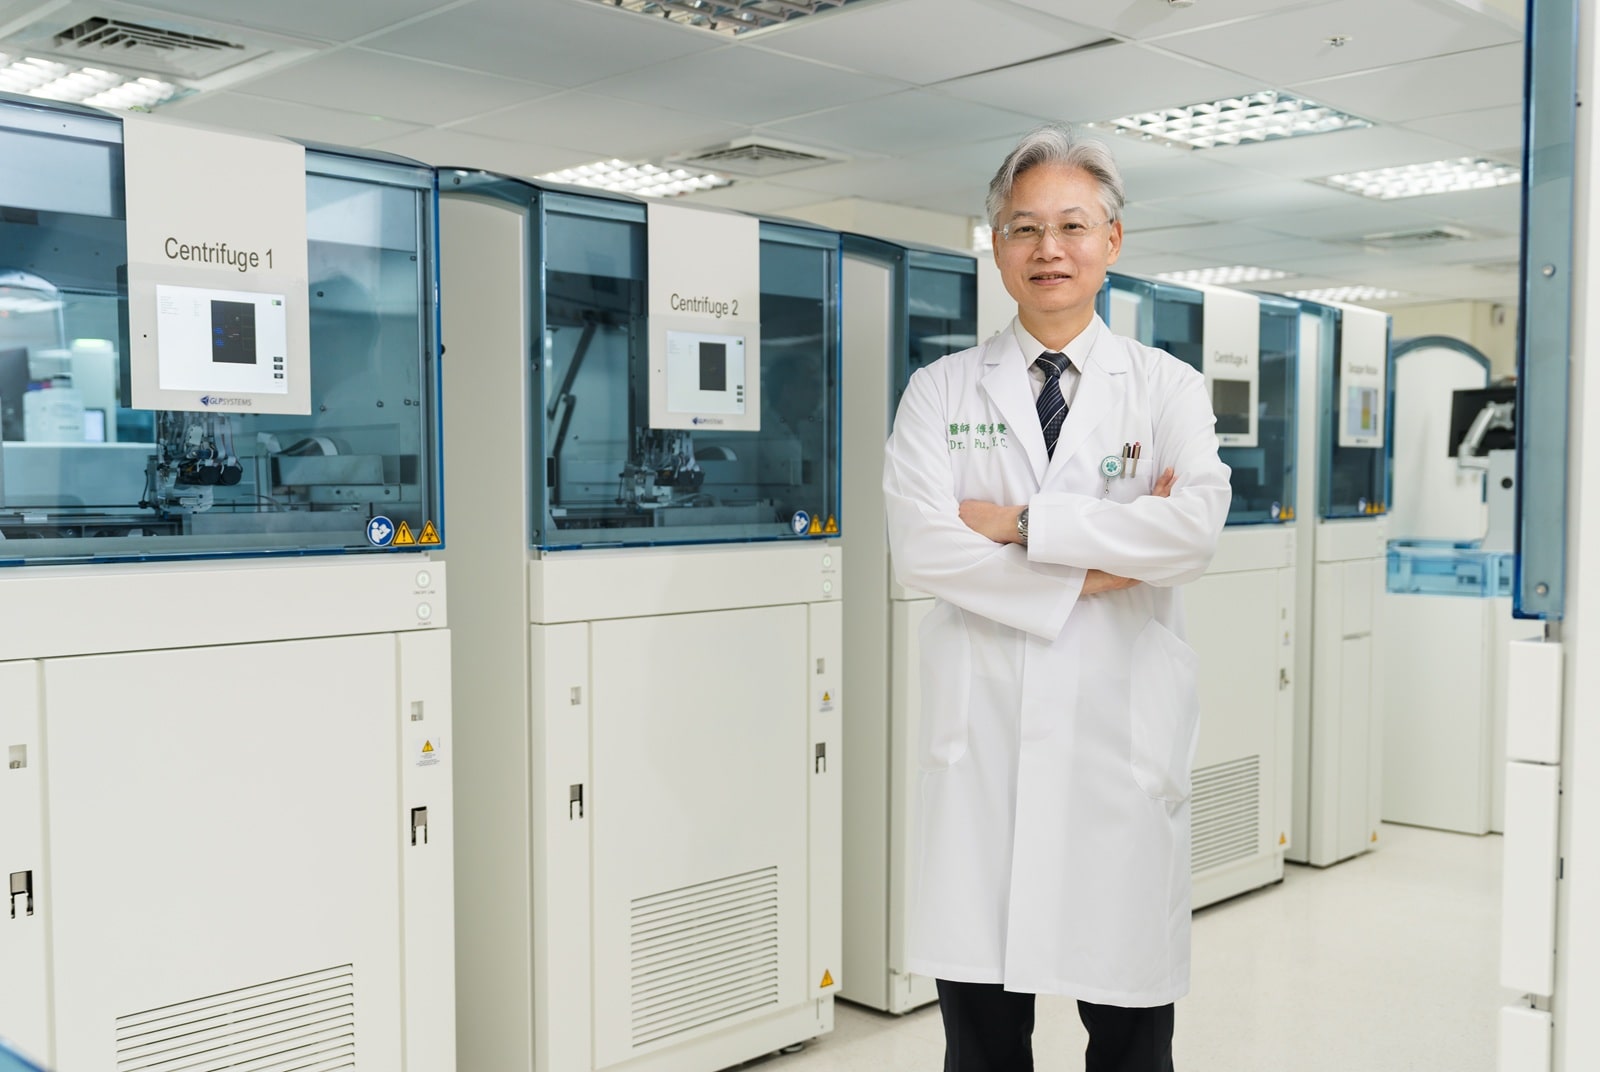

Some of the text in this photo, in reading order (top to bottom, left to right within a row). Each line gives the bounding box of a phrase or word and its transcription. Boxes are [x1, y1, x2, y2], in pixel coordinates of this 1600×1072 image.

[164, 237, 273, 272] Centrifuge 1
[670, 293, 739, 319] Centrifuge 2
[209, 397, 252, 406] GLPSYSTEMS
[949, 422, 970, 436] 醫師
[949, 439, 966, 450] Dr.
